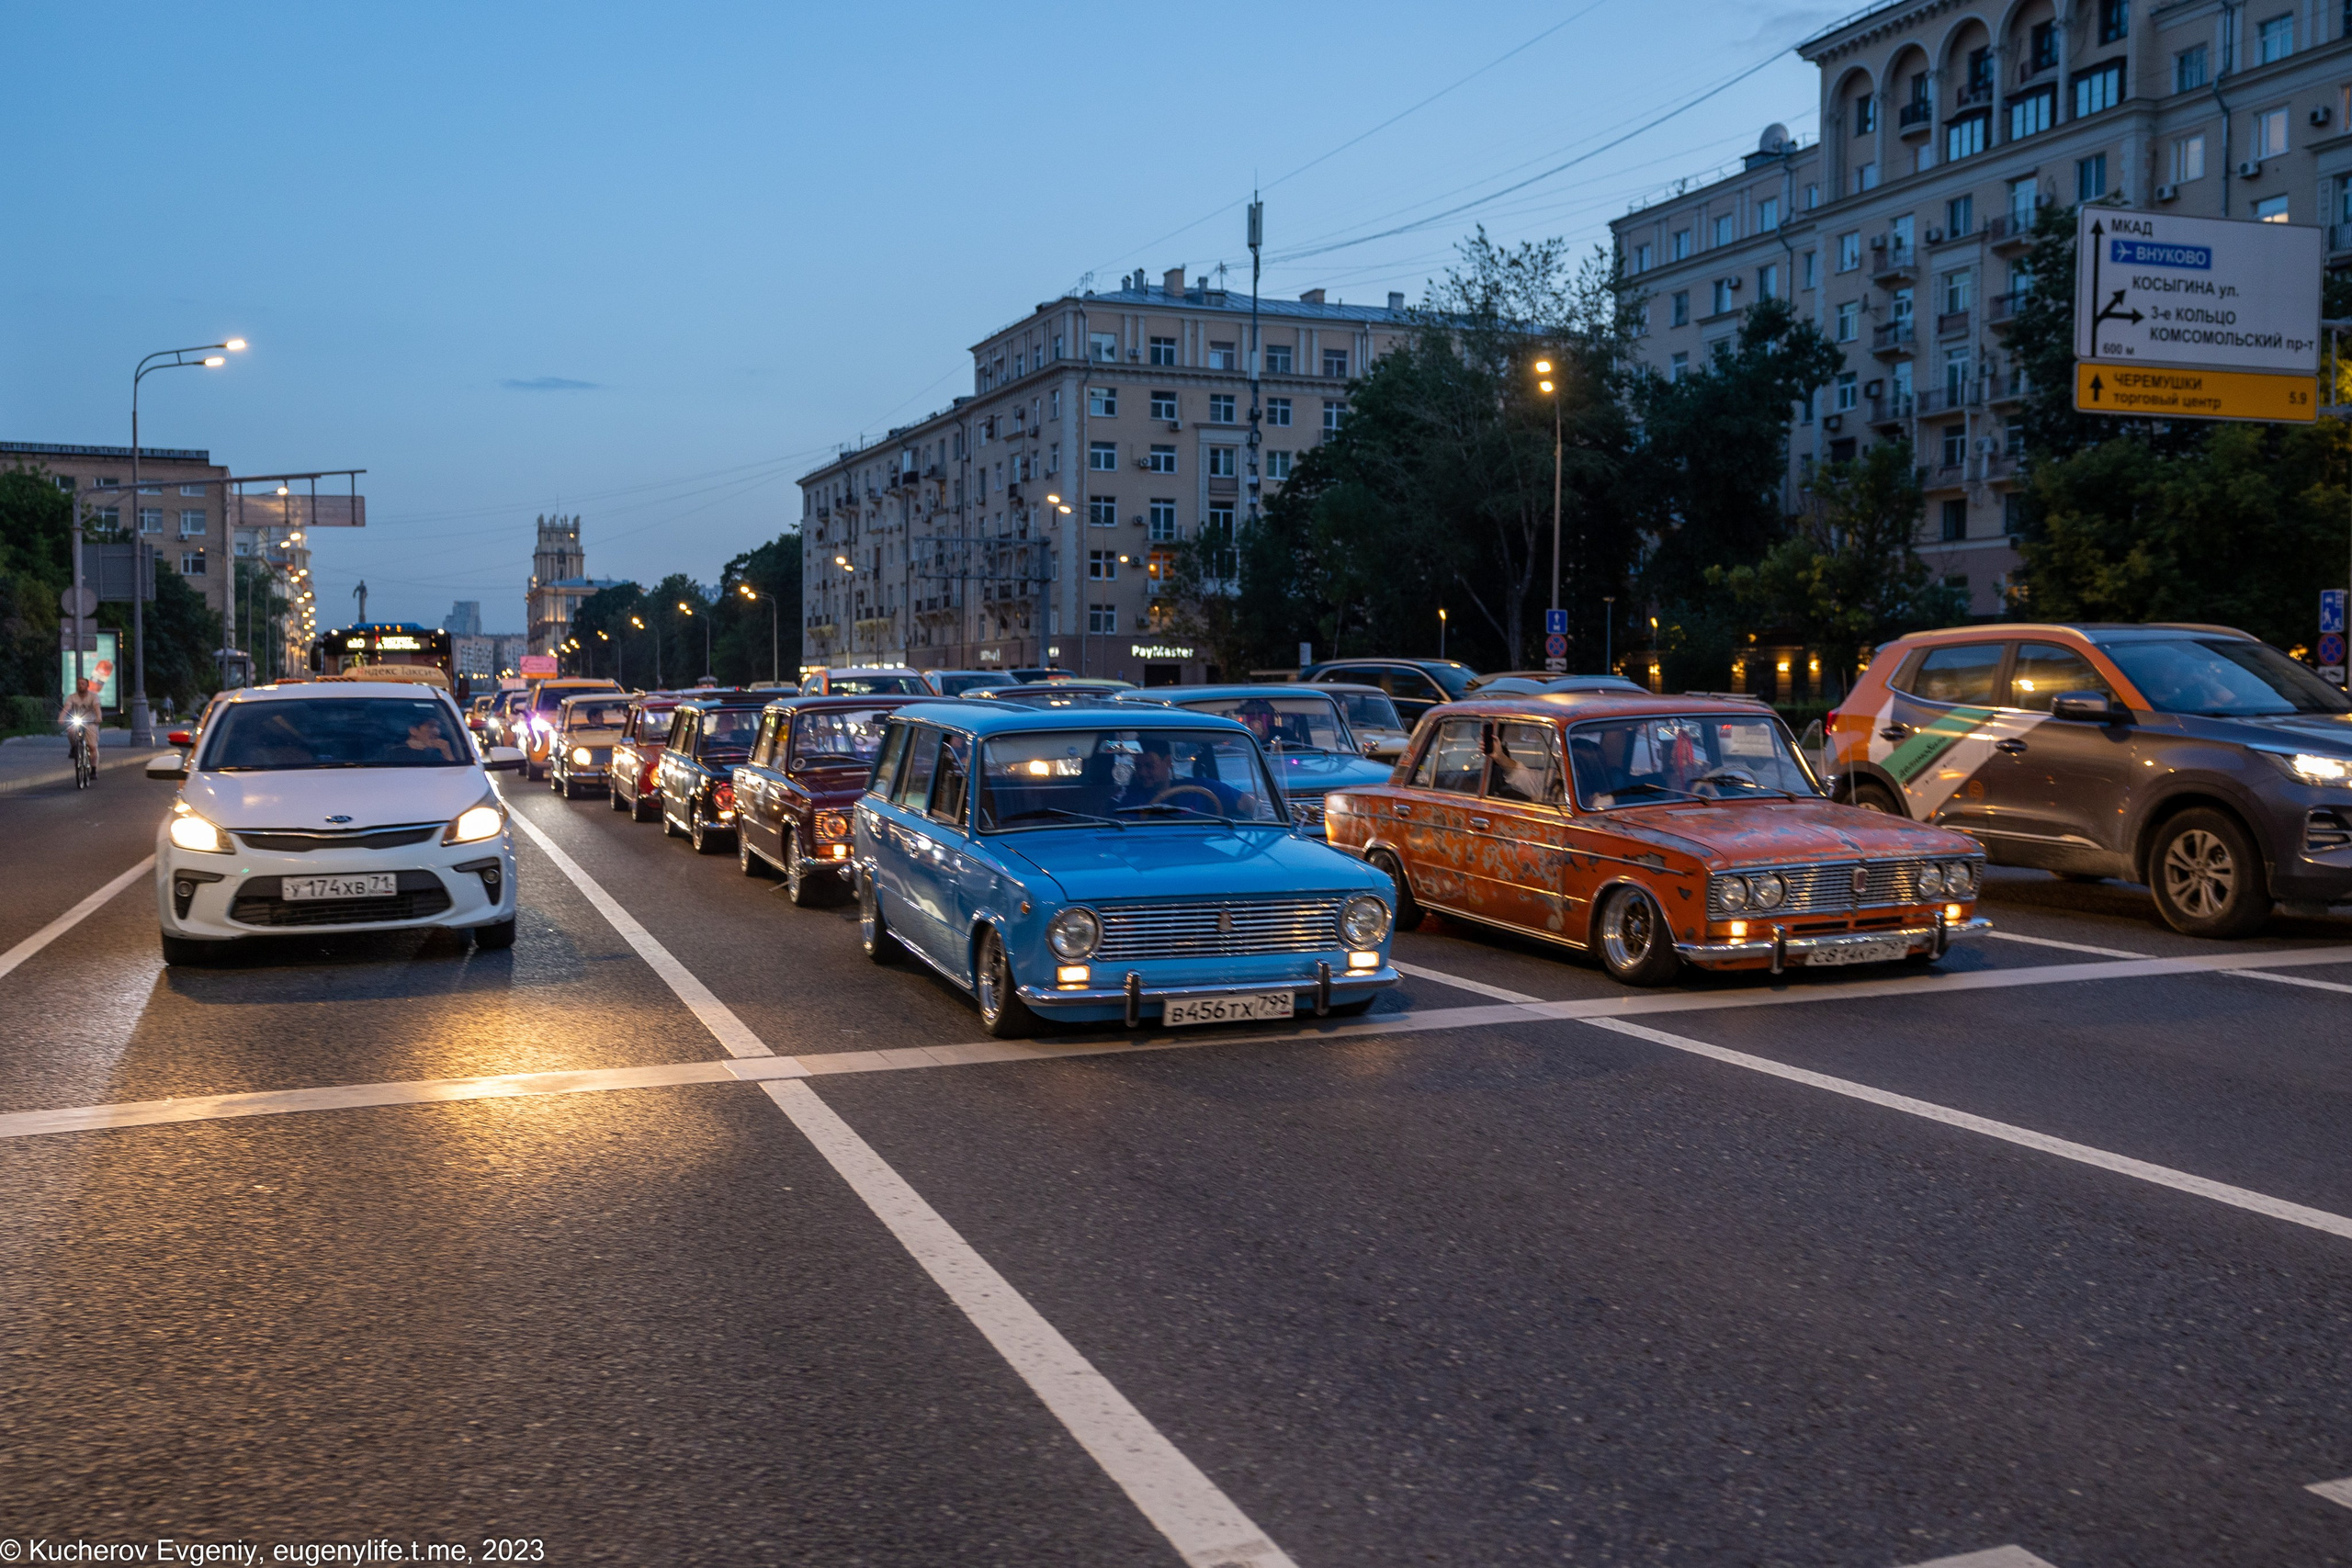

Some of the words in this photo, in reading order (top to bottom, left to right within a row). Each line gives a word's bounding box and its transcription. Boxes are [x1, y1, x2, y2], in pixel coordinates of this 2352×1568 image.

[2111, 218, 2153, 237] МКАД
[2135, 245, 2207, 265] ВНУКОВО
[2132, 276, 2215, 295] КОСЫГИНА
[2219, 286, 2240, 299] ул.
[2151, 306, 2171, 321] 3-е
[2176, 308, 2236, 325] КОЛЬЦО
[2103, 343, 2123, 355] 600
[2125, 347, 2135, 355] м
[2150, 327, 2282, 348] КОМСОМОЛЬСКИЙ
[2287, 338, 2314, 353] пр-т
[2113, 373, 2202, 390] ЧЕРЕМУШКИ
[2113, 392, 2178, 407] торговый
[2183, 397, 2222, 410] центр
[2288, 391, 2308, 405] 5.9
[1131, 645, 1194, 660] PayMaster
[356, 667, 398, 677] Яндекс
[370, 875, 390, 889] 71
[1172, 1000, 1254, 1022] В456ТХ
[1257, 994, 1291, 1011] 799
